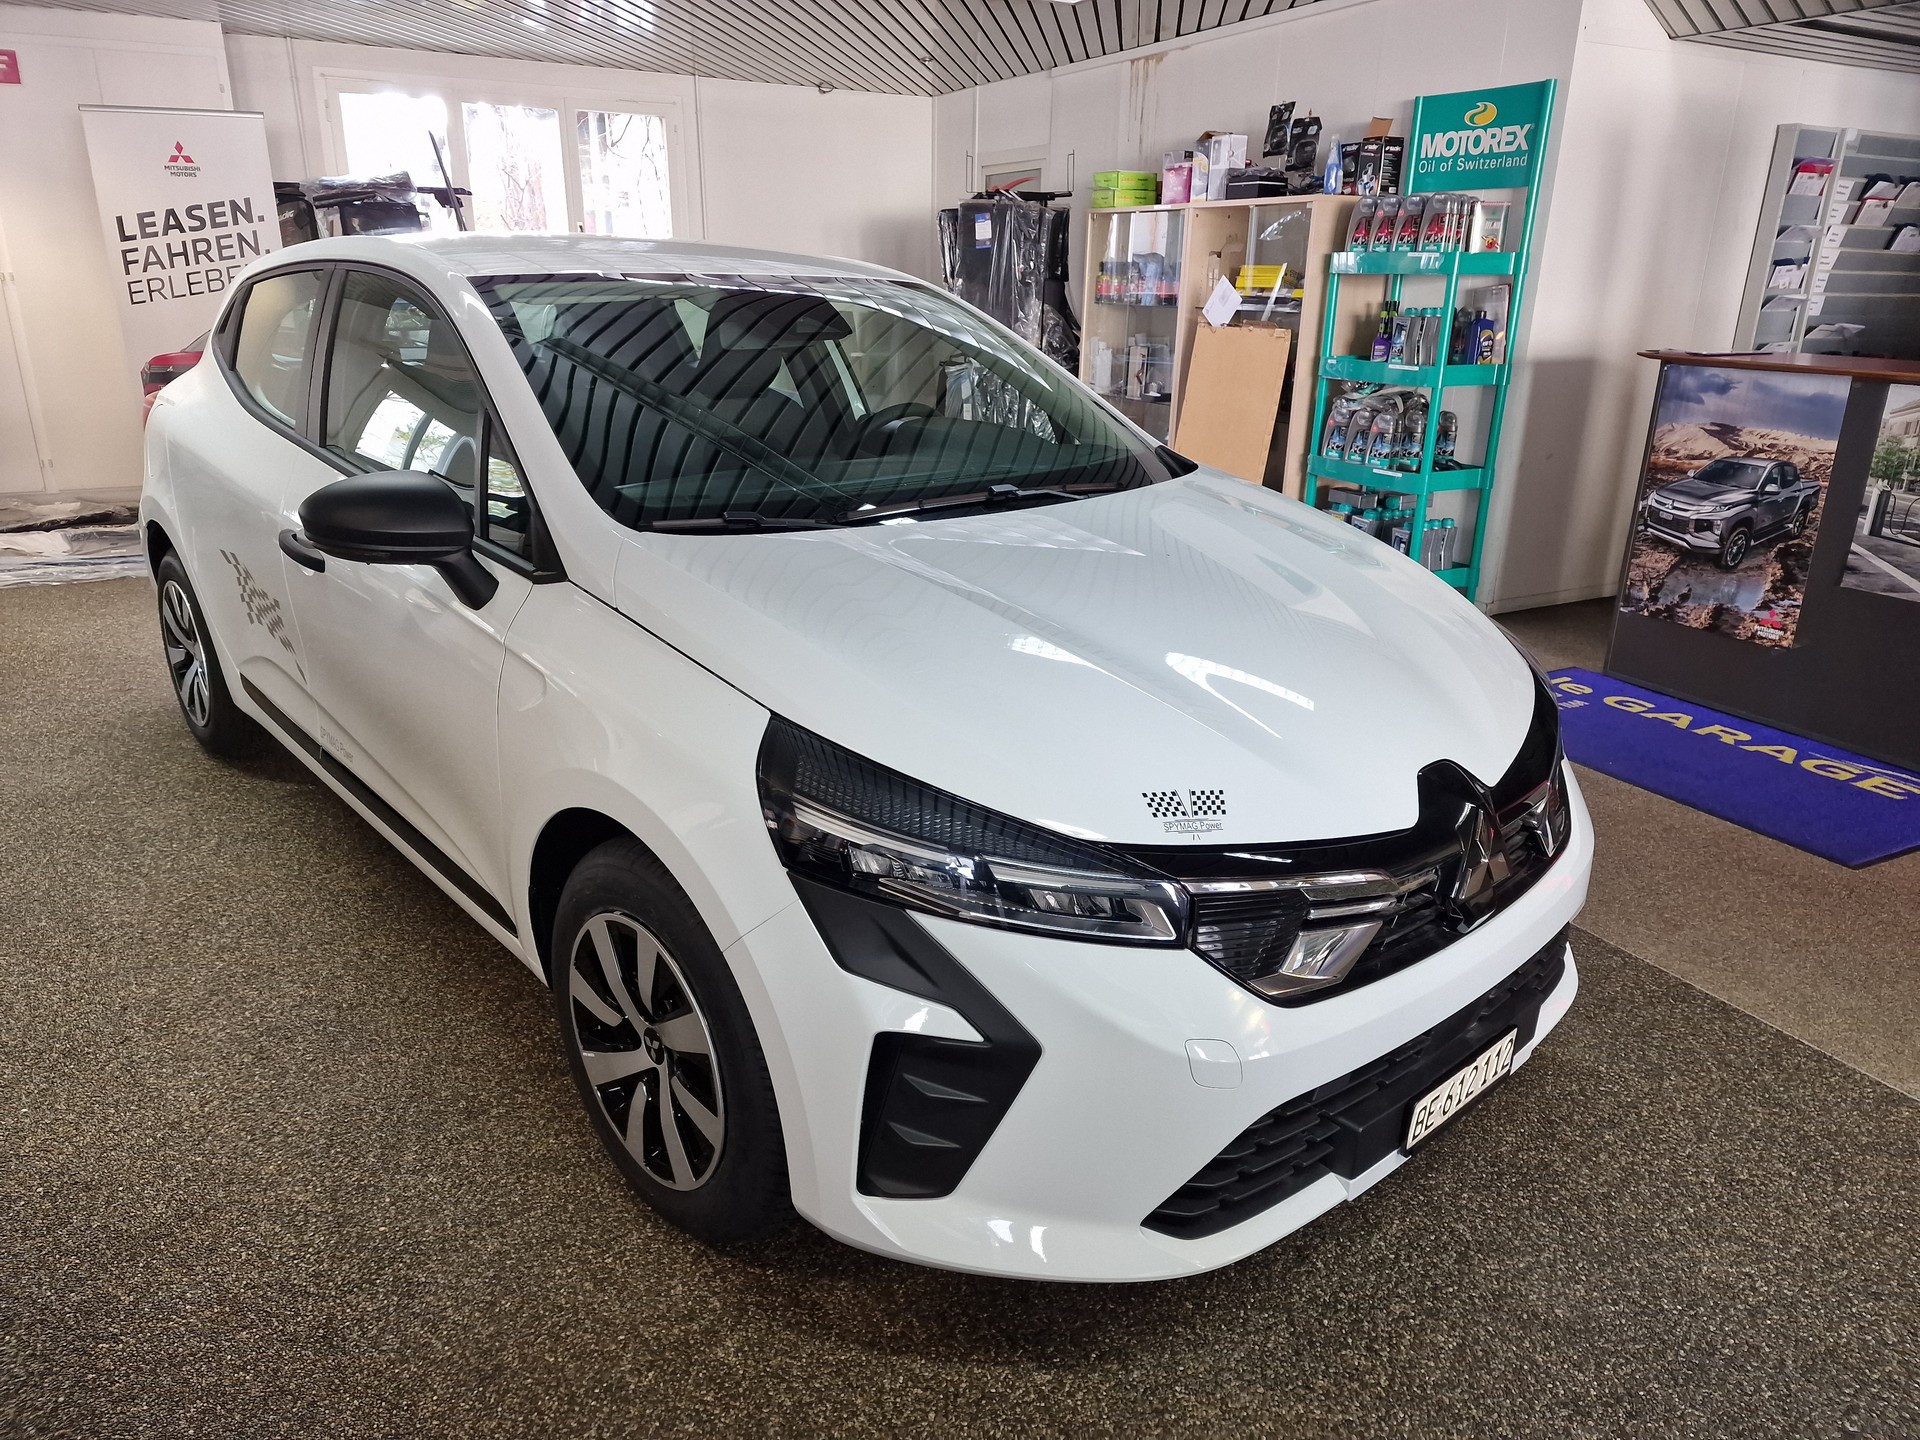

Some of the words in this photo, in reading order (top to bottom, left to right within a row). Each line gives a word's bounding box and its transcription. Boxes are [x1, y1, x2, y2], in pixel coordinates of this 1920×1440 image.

[1418, 158, 1435, 174] Oil
[1439, 157, 1453, 172] of
[1456, 153, 1528, 171] Switzerland
[115, 197, 265, 242] LEASEN.
[120, 229, 271, 276] FAHREN.
[126, 263, 249, 305] ERLEBE
[1603, 695, 1920, 801] GARAGE
[1163, 821, 1199, 831] SPYMAG
[1200, 821, 1222, 830] Power
